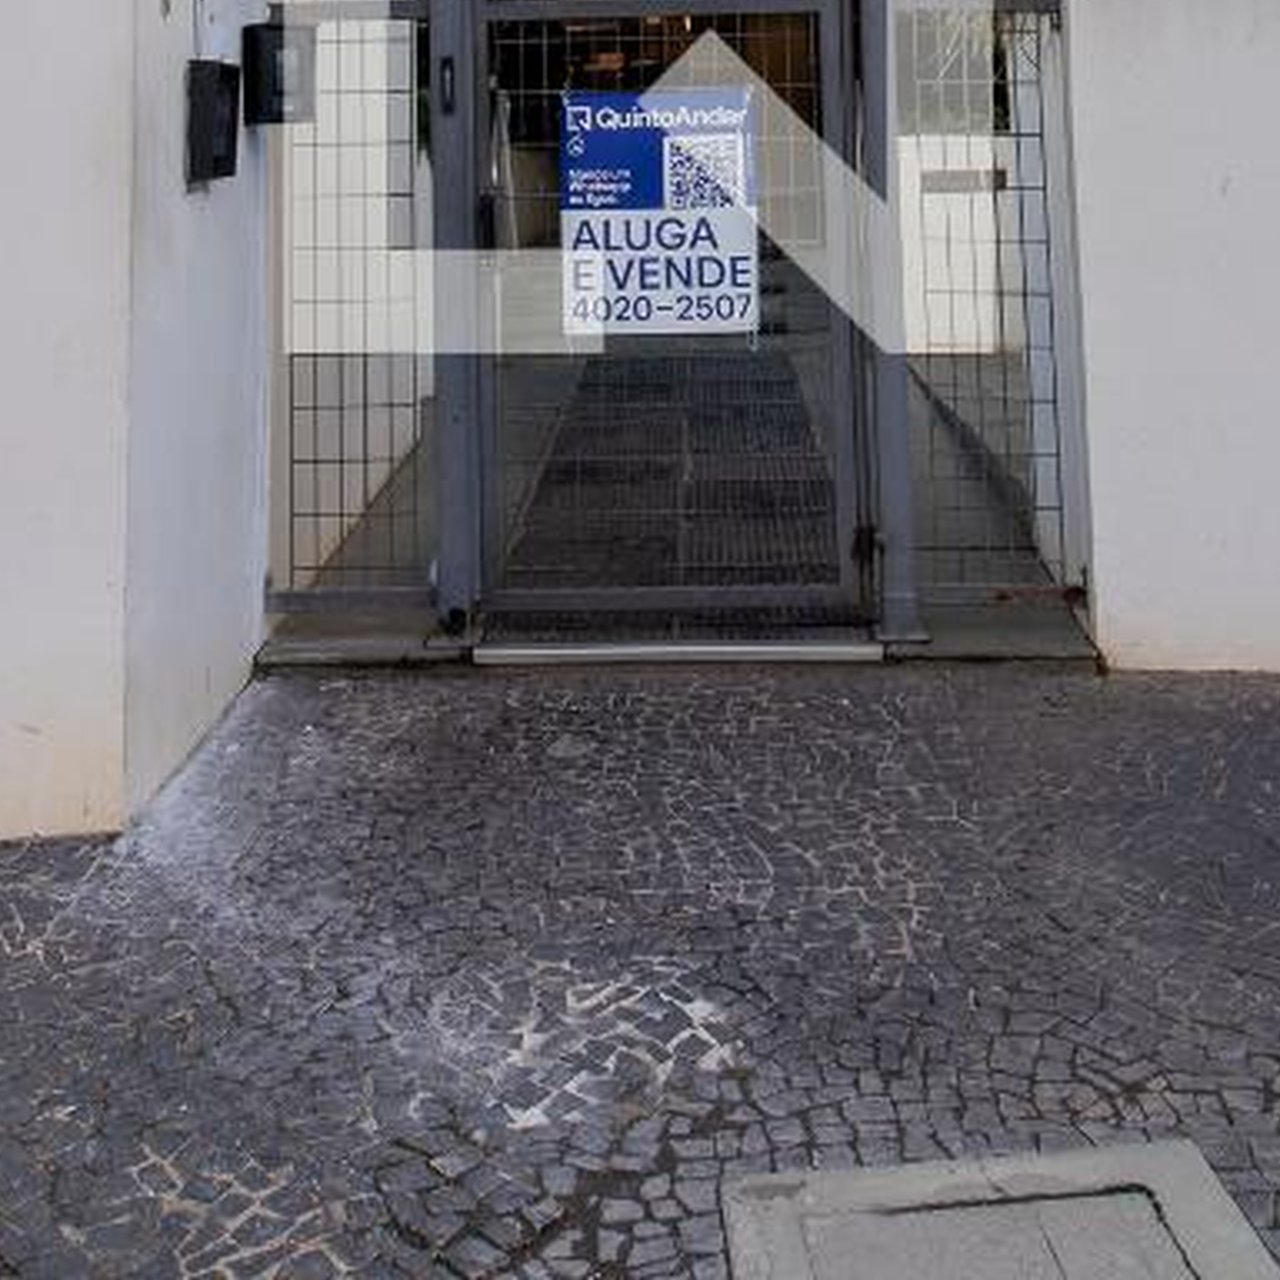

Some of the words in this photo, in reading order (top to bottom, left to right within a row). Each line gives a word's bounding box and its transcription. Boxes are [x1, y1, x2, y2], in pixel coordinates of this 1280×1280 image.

[573, 217, 718, 251] ALUGA
[573, 260, 596, 291] E
[607, 256, 752, 290] VENDE
[573, 295, 752, 322] 4020-2507
